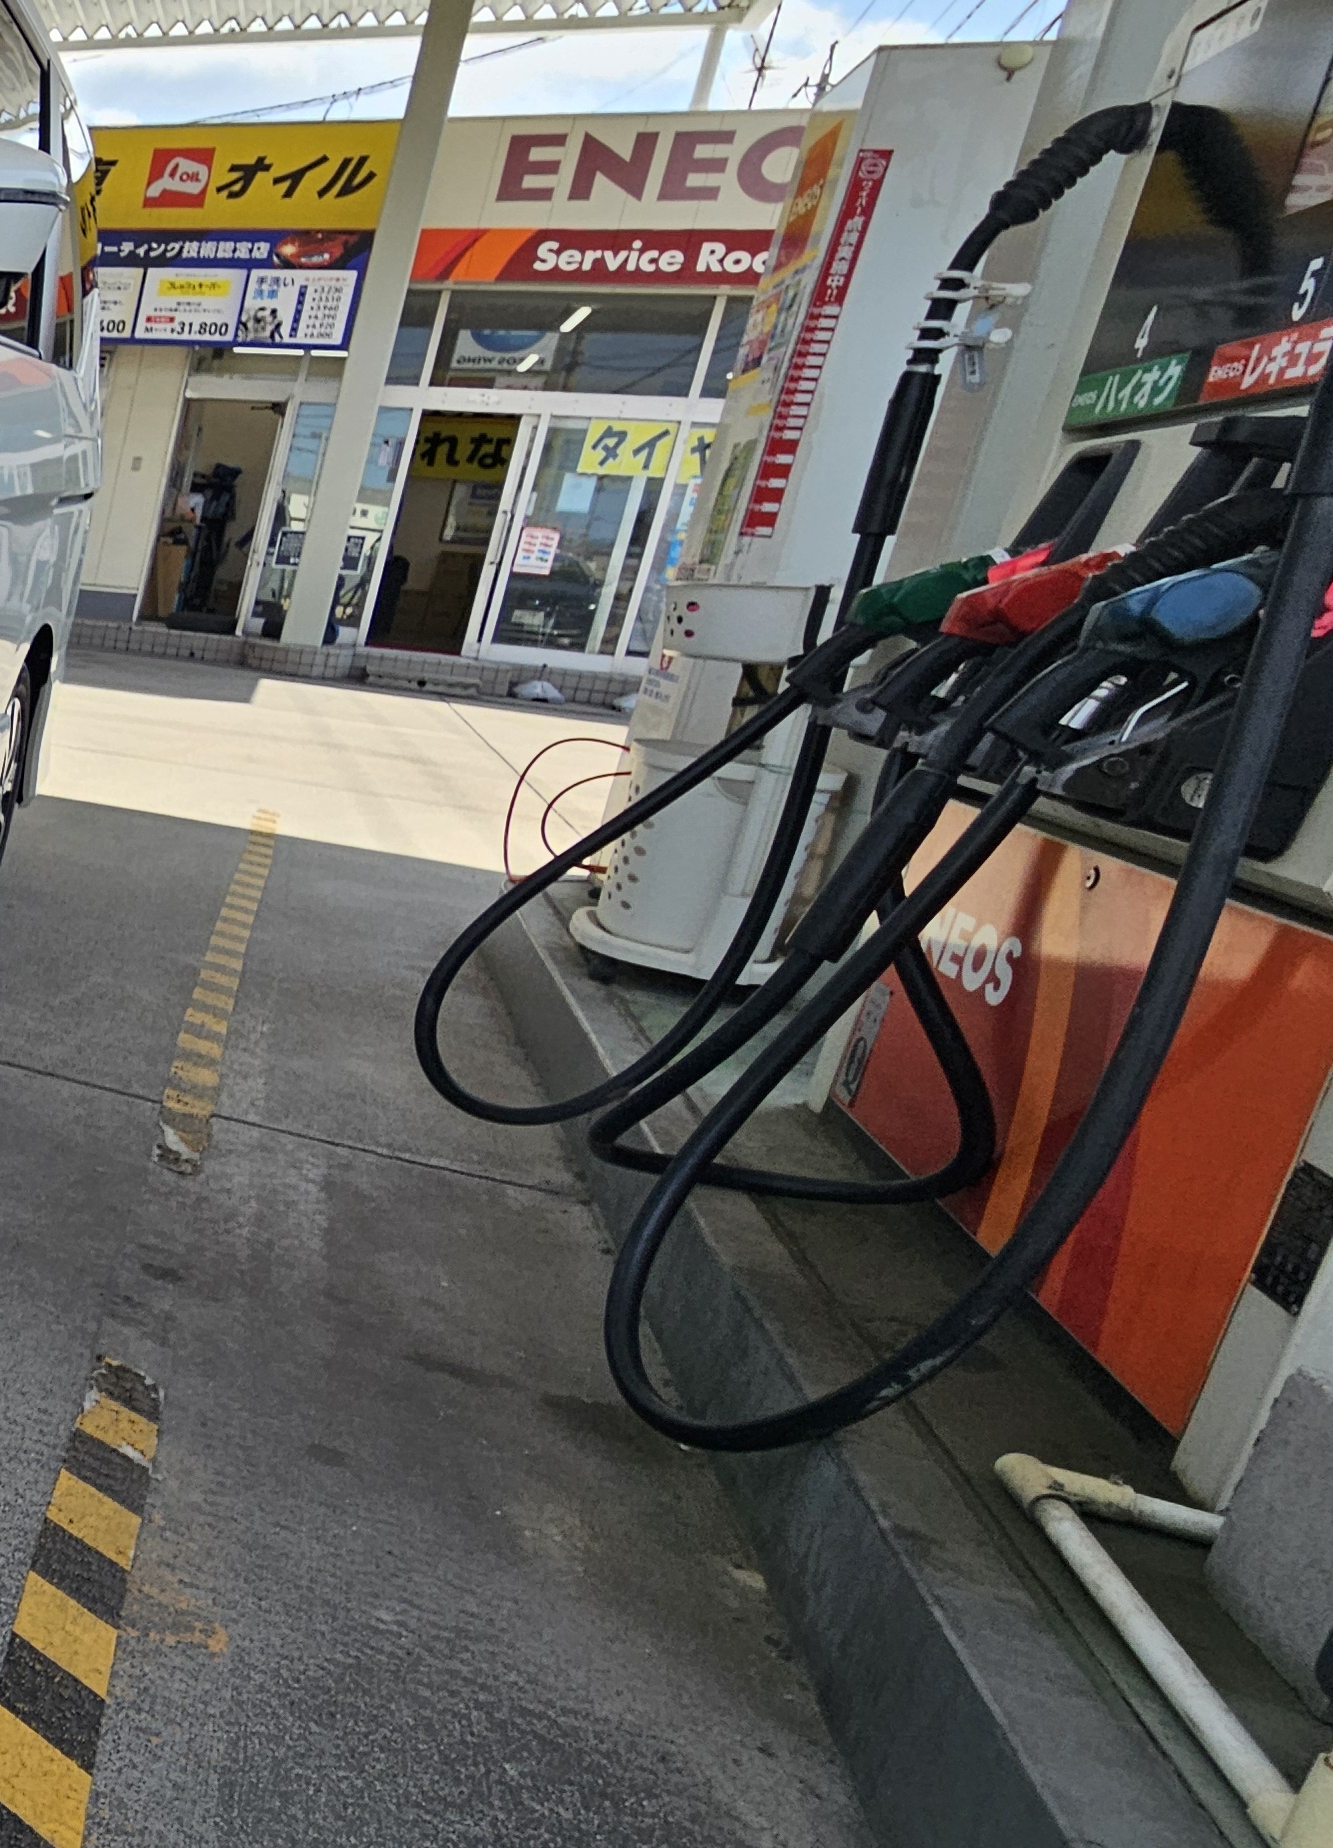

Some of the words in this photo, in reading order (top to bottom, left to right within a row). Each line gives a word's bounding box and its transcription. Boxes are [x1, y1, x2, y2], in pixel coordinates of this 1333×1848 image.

[179, 171, 202, 183] OIL
[216, 154, 377, 199] オイル
[495, 125, 806, 204] ENEO
[533, 239, 684, 273] Service
[696, 242, 770, 274] Roo
[1291, 256, 1324, 321] 5
[1134, 304, 1158, 358] 4
[1095, 359, 1183, 414] ハイオク
[416, 430, 512, 470] れな
[918, 906, 1023, 1006] NEOS
